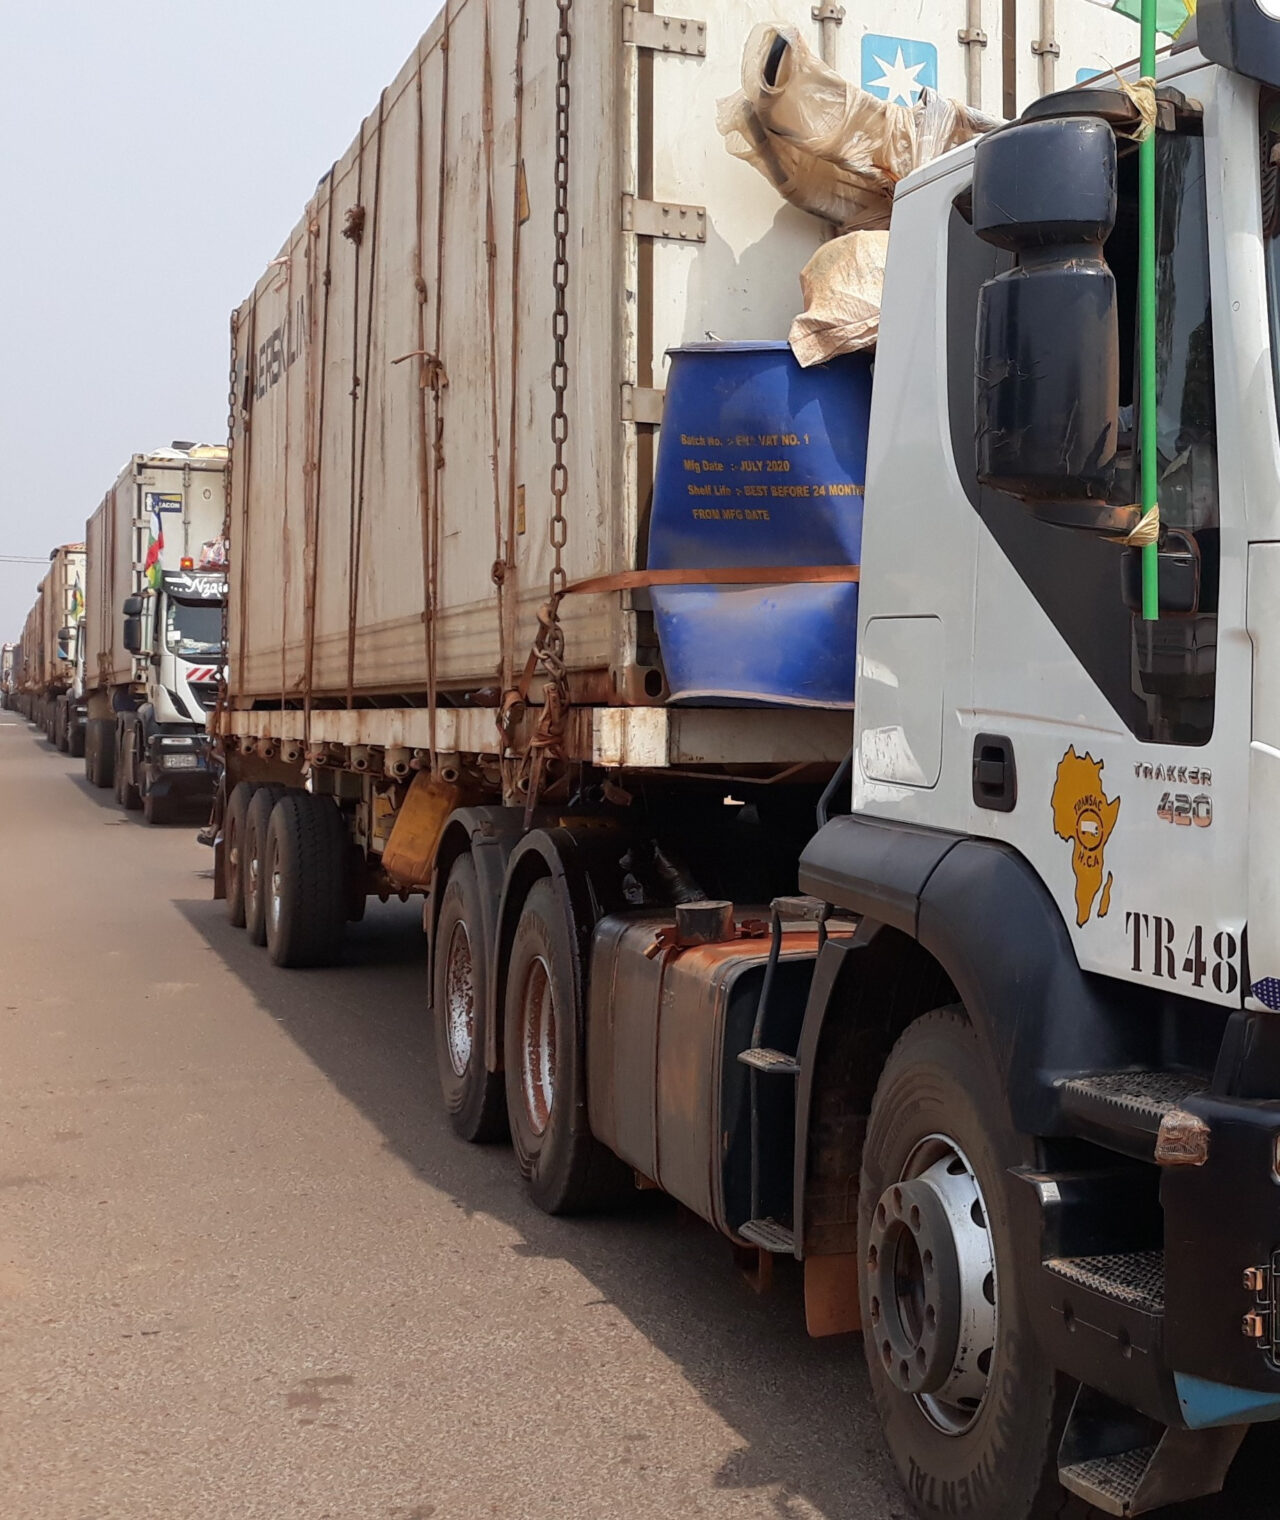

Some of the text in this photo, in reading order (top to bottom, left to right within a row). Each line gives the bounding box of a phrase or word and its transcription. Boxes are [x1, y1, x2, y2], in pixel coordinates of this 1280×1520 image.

[781, 434, 800, 446] NO.
[803, 433, 809, 445] 1
[740, 460, 762, 472] JULY
[766, 460, 790, 472] 2020
[744, 485, 768, 496] BEST
[771, 485, 810, 497] BEFORE
[812, 485, 826, 496] 24
[692, 509, 720, 520] FROM
[745, 510, 770, 520] DATE
[1133, 761, 1213, 787] TRAKKER
[1156, 792, 1214, 828] 420
[1125, 911, 1238, 994] TR48
